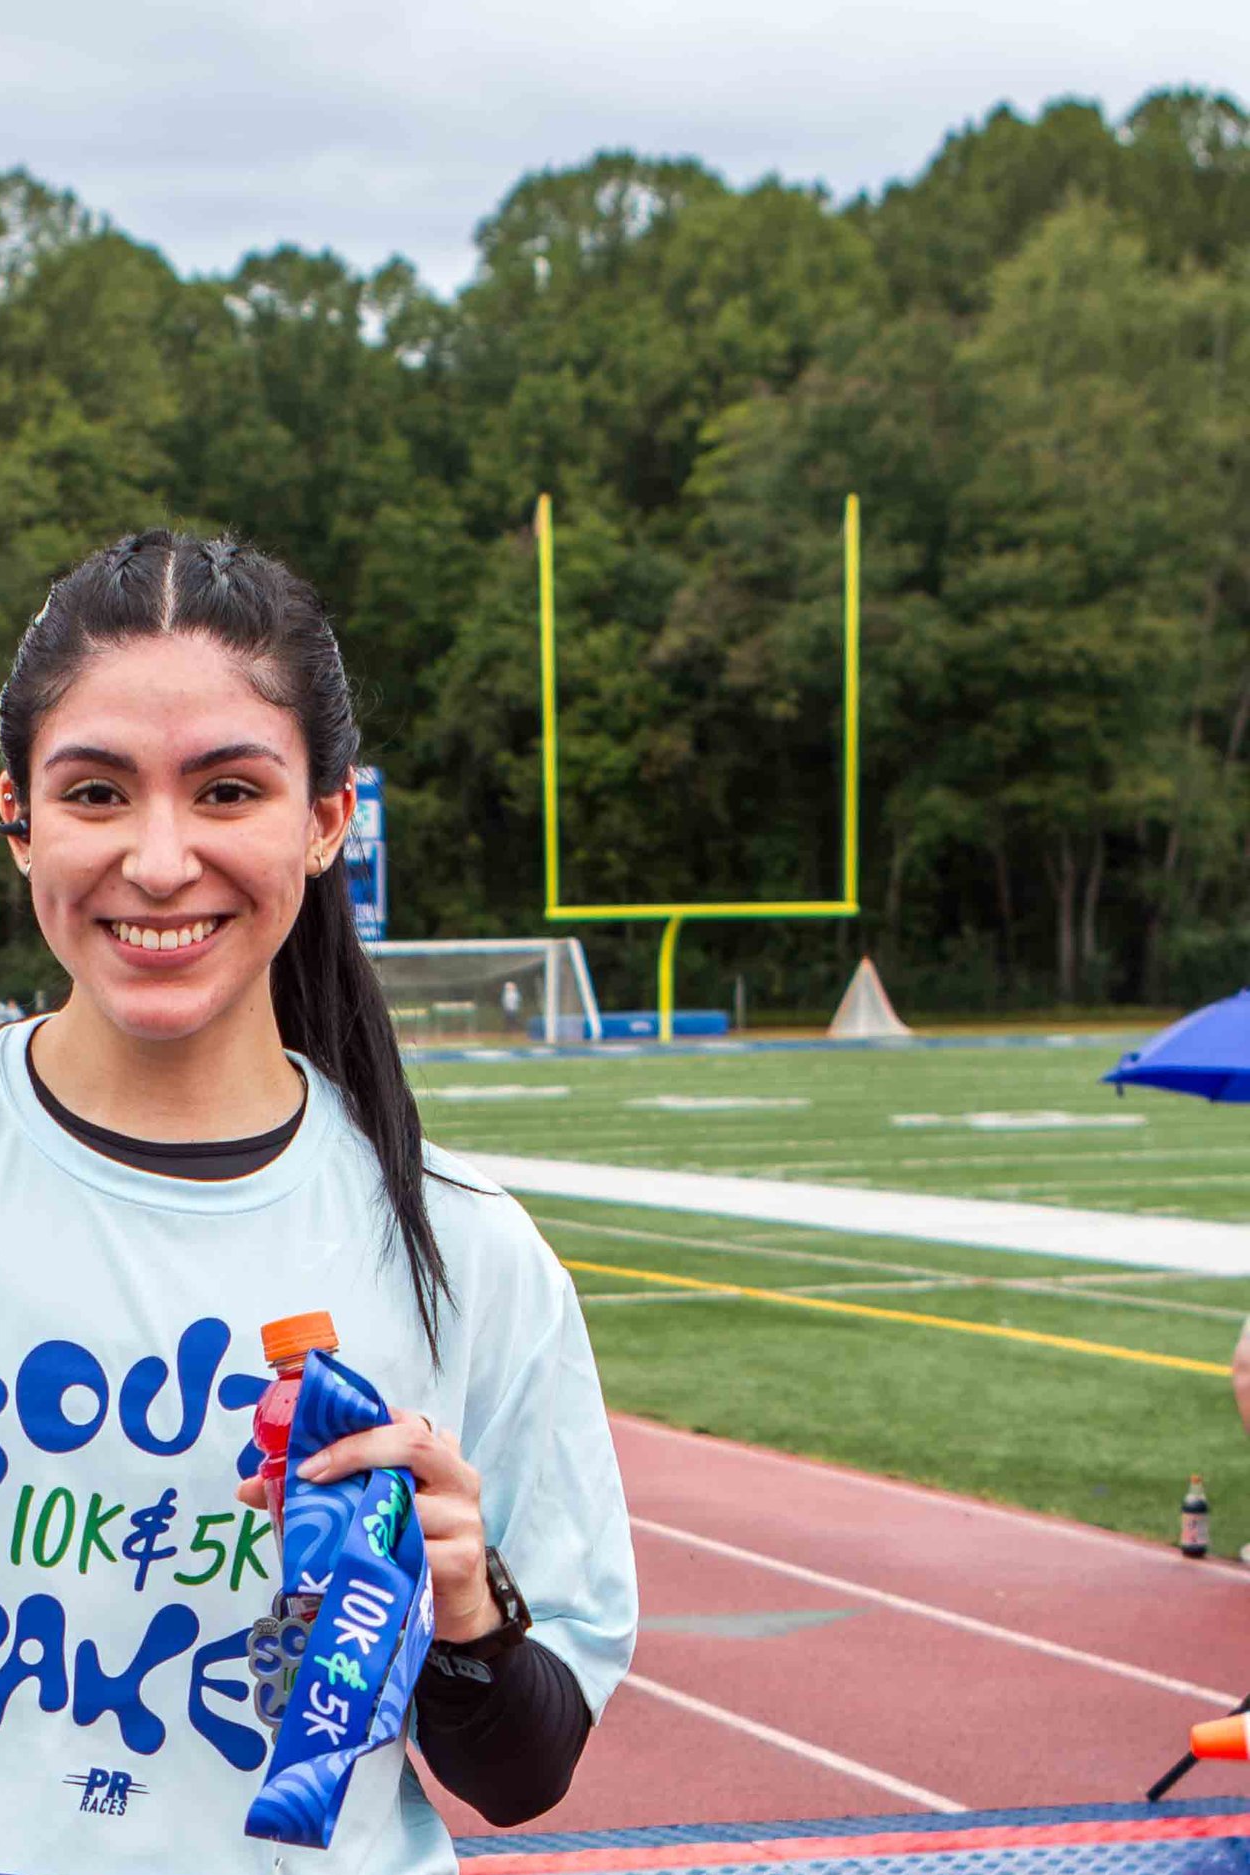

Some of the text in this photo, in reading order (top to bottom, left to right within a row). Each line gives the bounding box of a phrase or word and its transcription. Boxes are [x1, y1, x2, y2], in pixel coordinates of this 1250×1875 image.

[10, 1485, 126, 1576] 10K
[121, 1487, 178, 1592] &
[173, 1508, 274, 1592] 5K
[333, 1578, 395, 1655] 10K
[301, 1681, 350, 1746] 5K
[79, 1796, 128, 1817] RACES
[84, 1766, 132, 1800] PR
